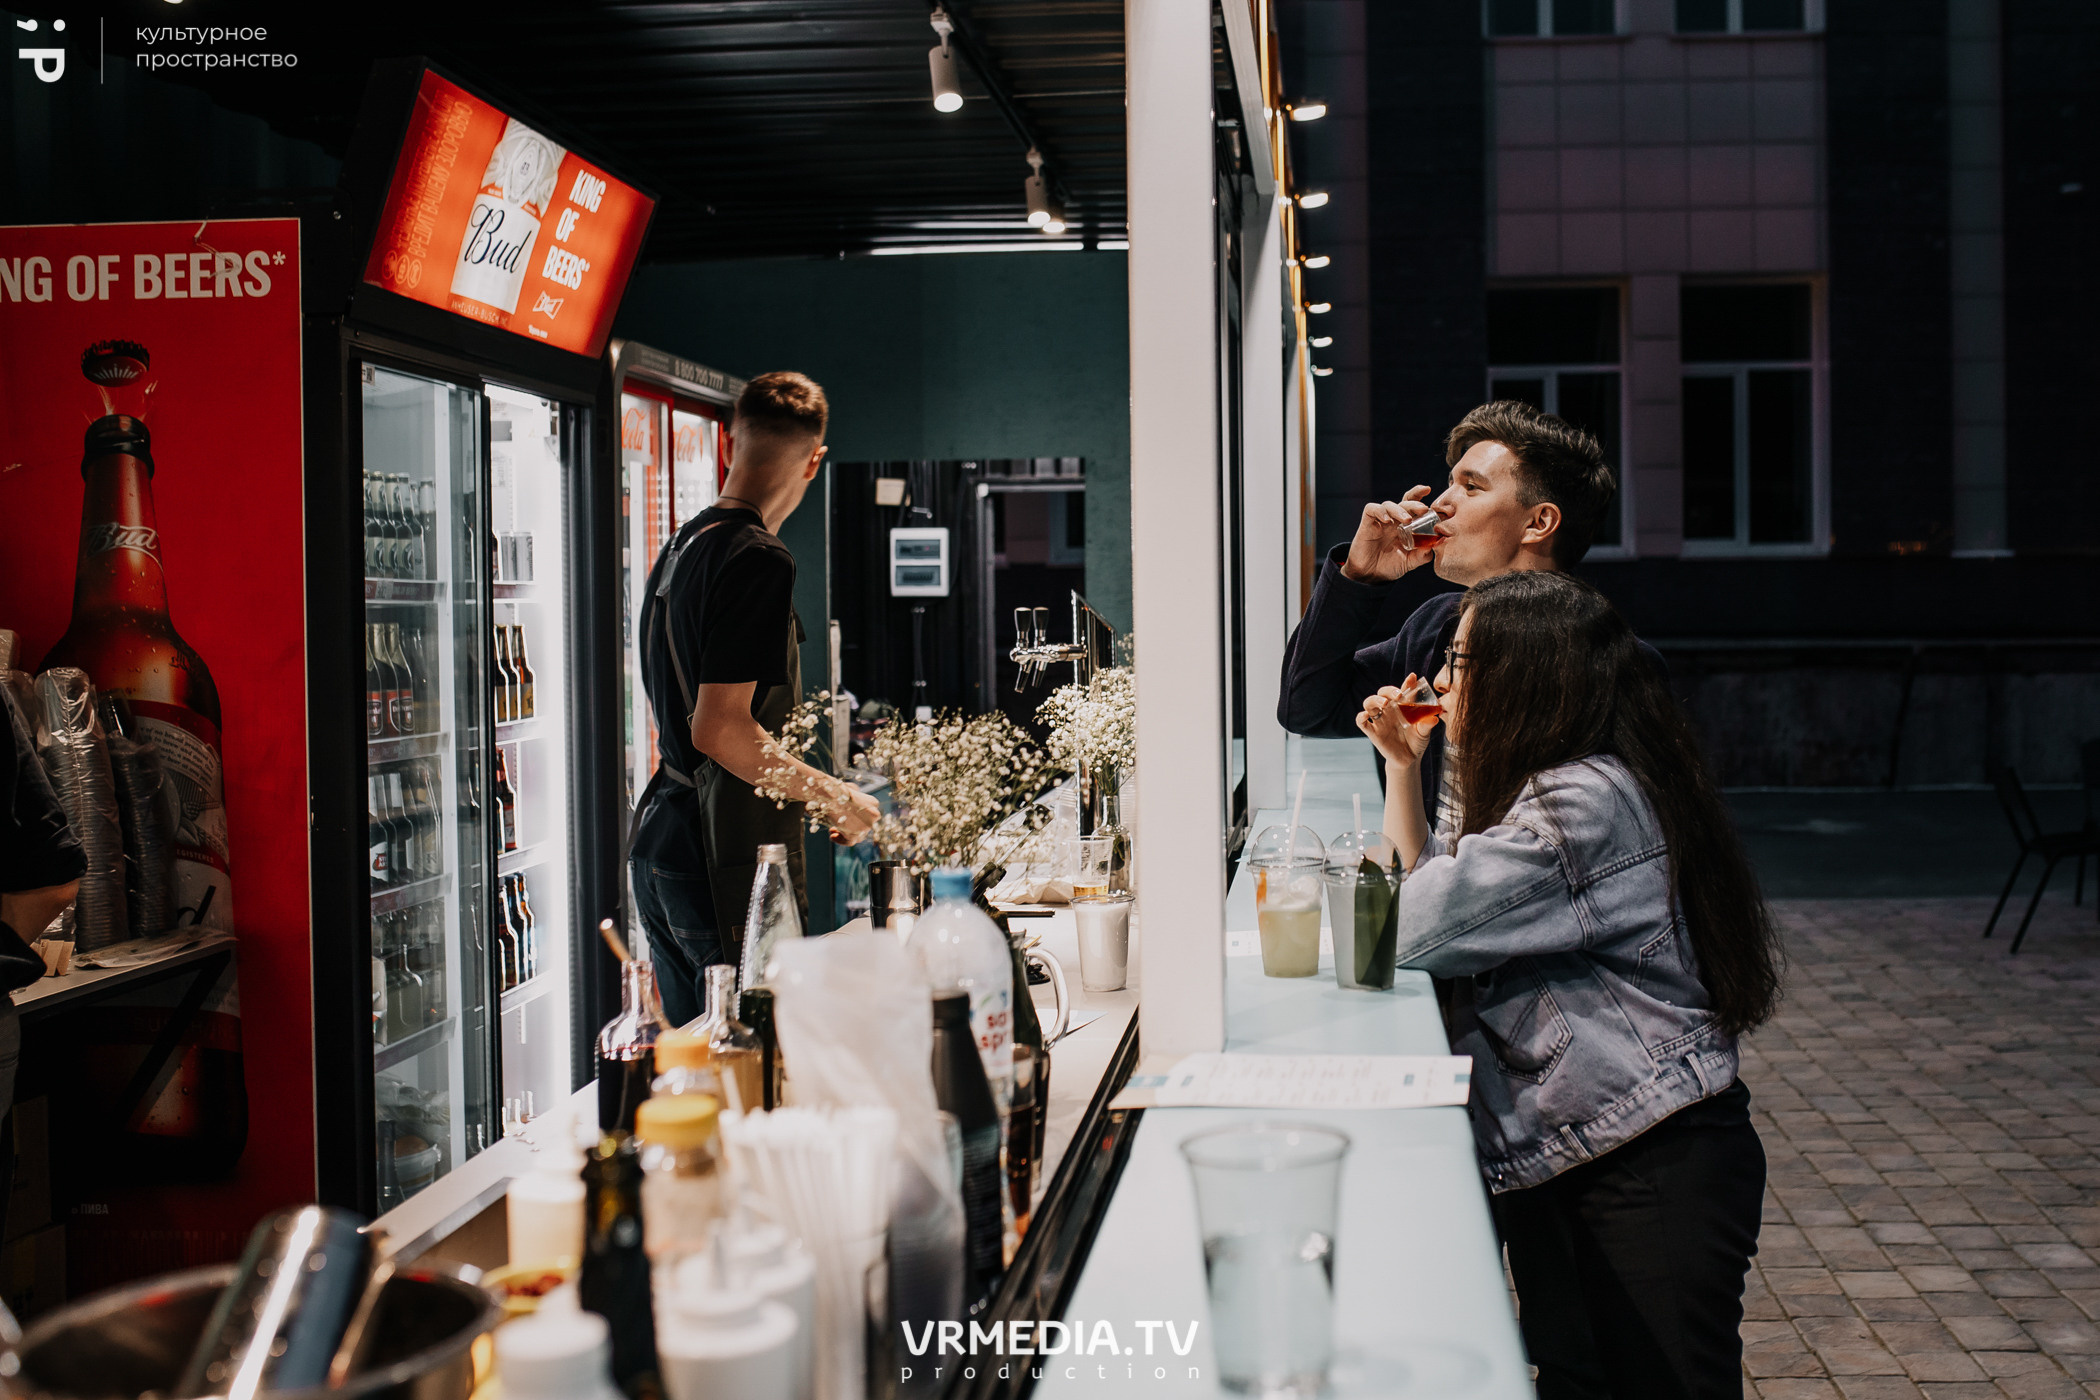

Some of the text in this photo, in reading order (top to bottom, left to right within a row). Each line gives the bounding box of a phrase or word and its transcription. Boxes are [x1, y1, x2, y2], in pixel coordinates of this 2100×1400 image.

[425, 161, 453, 214] ВАШЕМУ
[442, 101, 474, 167] ЗДОРОВЬЮ
[569, 169, 606, 214] KING
[464, 203, 532, 273] Bud
[555, 207, 581, 243] OF
[0, 256, 52, 302] NG
[66, 254, 120, 302] OF
[83, 521, 157, 559] Bud
[176, 848, 214, 864] EGISTERED
[80, 1203, 109, 1216] ПИВА
